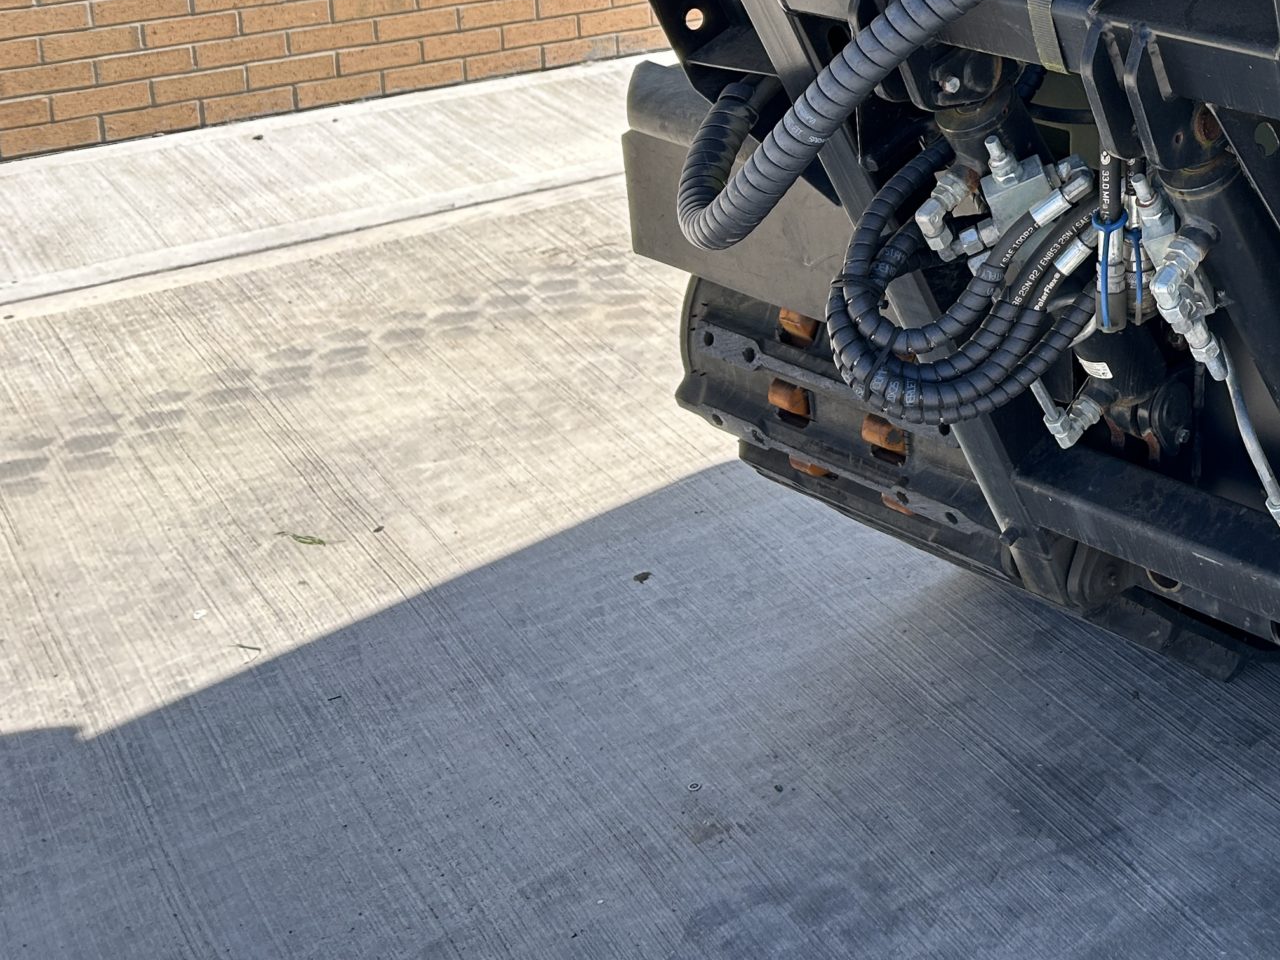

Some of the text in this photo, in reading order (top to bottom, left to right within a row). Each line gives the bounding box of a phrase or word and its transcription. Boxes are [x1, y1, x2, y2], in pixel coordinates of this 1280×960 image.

[1018, 279, 1033, 297] 2SN
[1028, 269, 1041, 282] R2
[1058, 229, 1074, 245] 2SN
